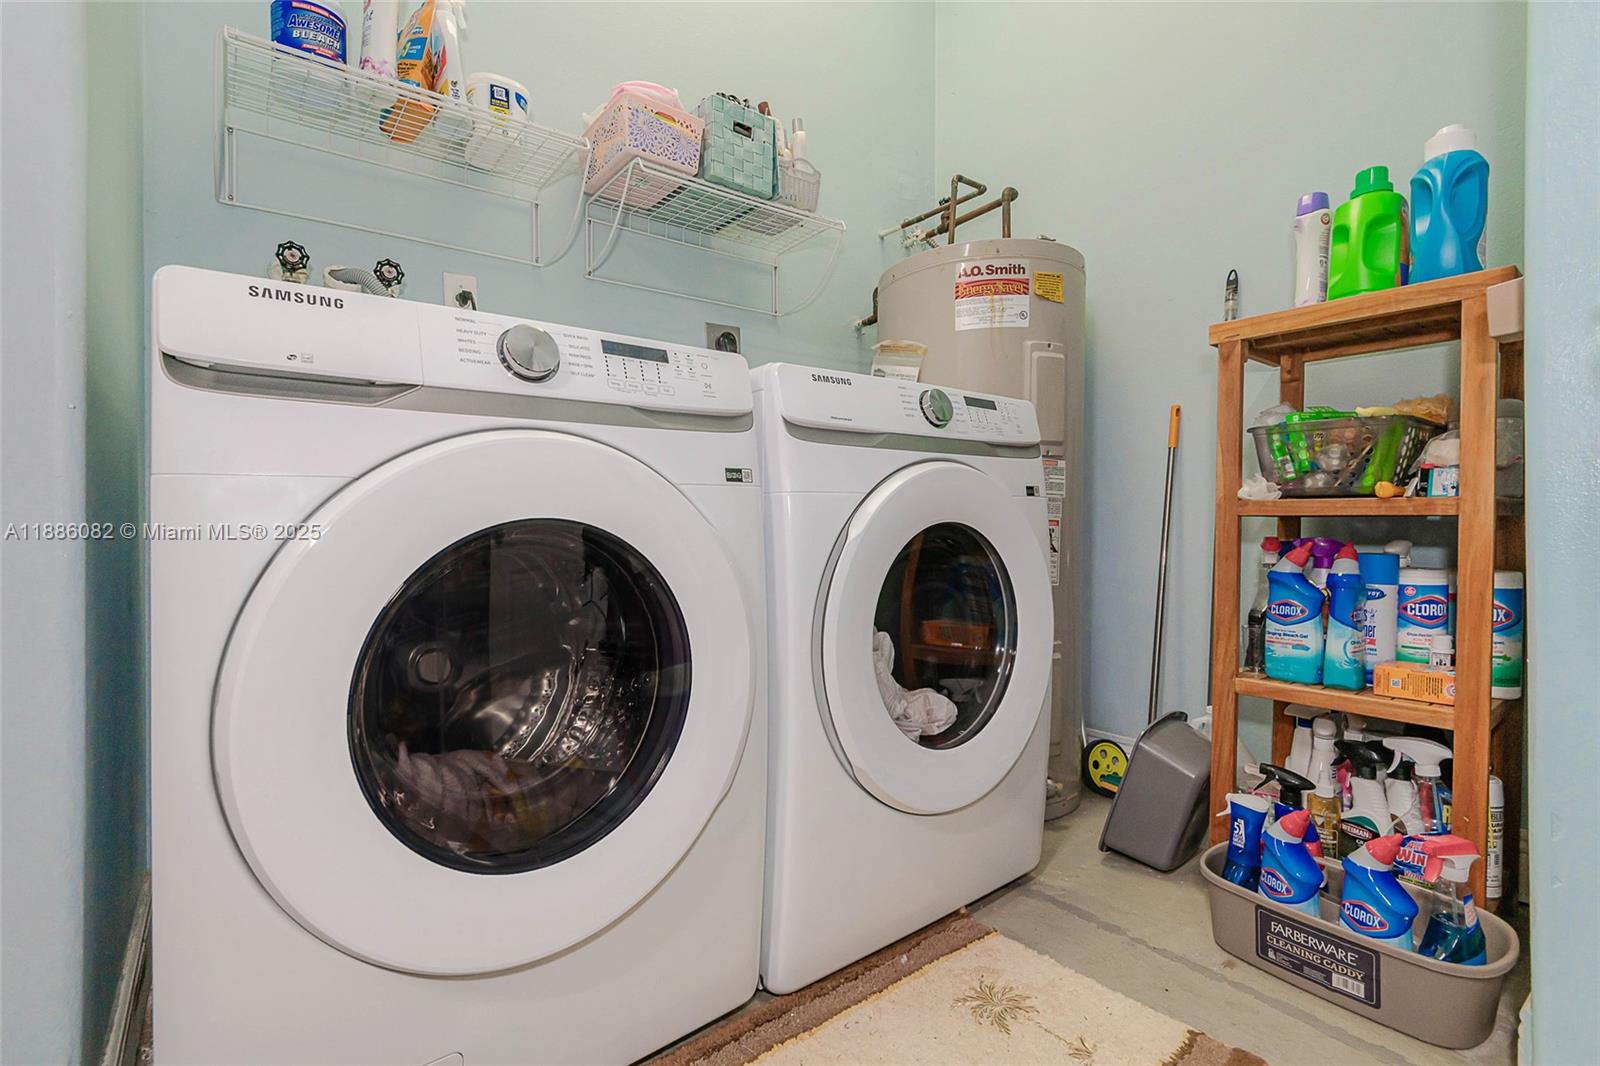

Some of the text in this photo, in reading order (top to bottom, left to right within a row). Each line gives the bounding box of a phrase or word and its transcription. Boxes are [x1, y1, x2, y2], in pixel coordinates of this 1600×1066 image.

[288, 13, 340, 40] AWESOME
[293, 29, 340, 50] BLEACH
[985, 263, 1026, 276] Smith
[248, 285, 344, 309] SAMSUNG
[812, 373, 852, 386] SAMSUNG
[1271, 604, 1302, 616] CLOROX
[1260, 872, 1287, 895] CLOROX
[1344, 903, 1381, 928] CLOROX
[1270, 921, 1357, 966] FARBERWARE
[1266, 935, 1321, 964] CLEANING
[1323, 960, 1364, 981] CADDY
